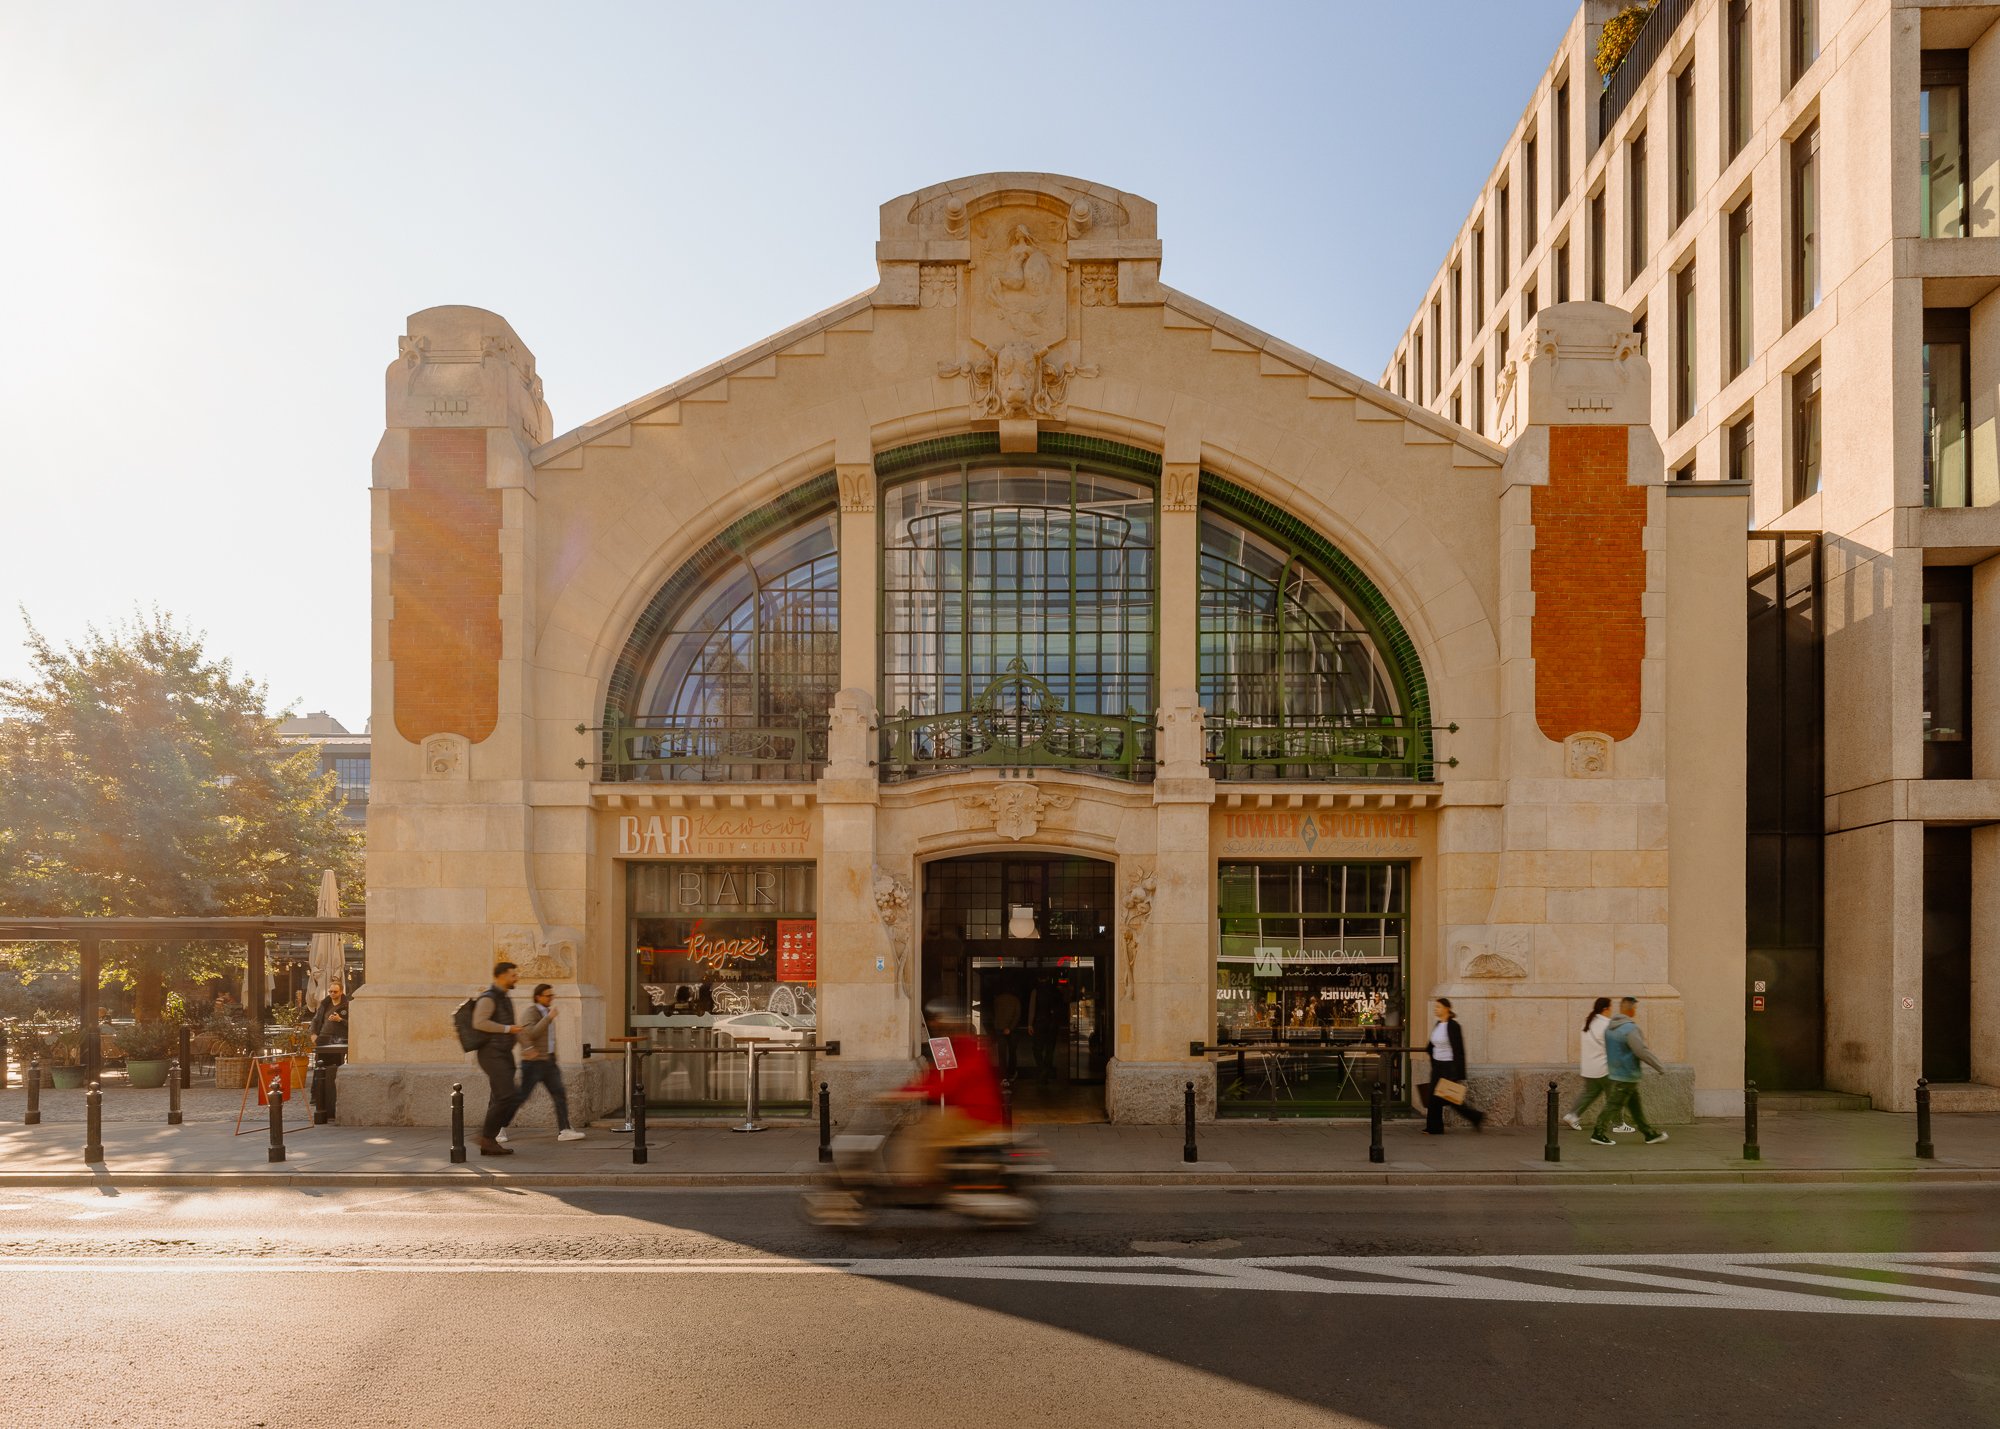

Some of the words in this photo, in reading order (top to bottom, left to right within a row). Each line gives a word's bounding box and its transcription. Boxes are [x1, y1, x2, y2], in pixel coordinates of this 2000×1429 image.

[619, 815, 693, 854] BAR
[695, 814, 812, 841] Kawowy
[1224, 814, 1302, 838] TOWARY
[678, 872, 776, 905] BAR
[684, 934, 769, 970] Ragazzi
[1287, 949, 1367, 964] VININOVA
